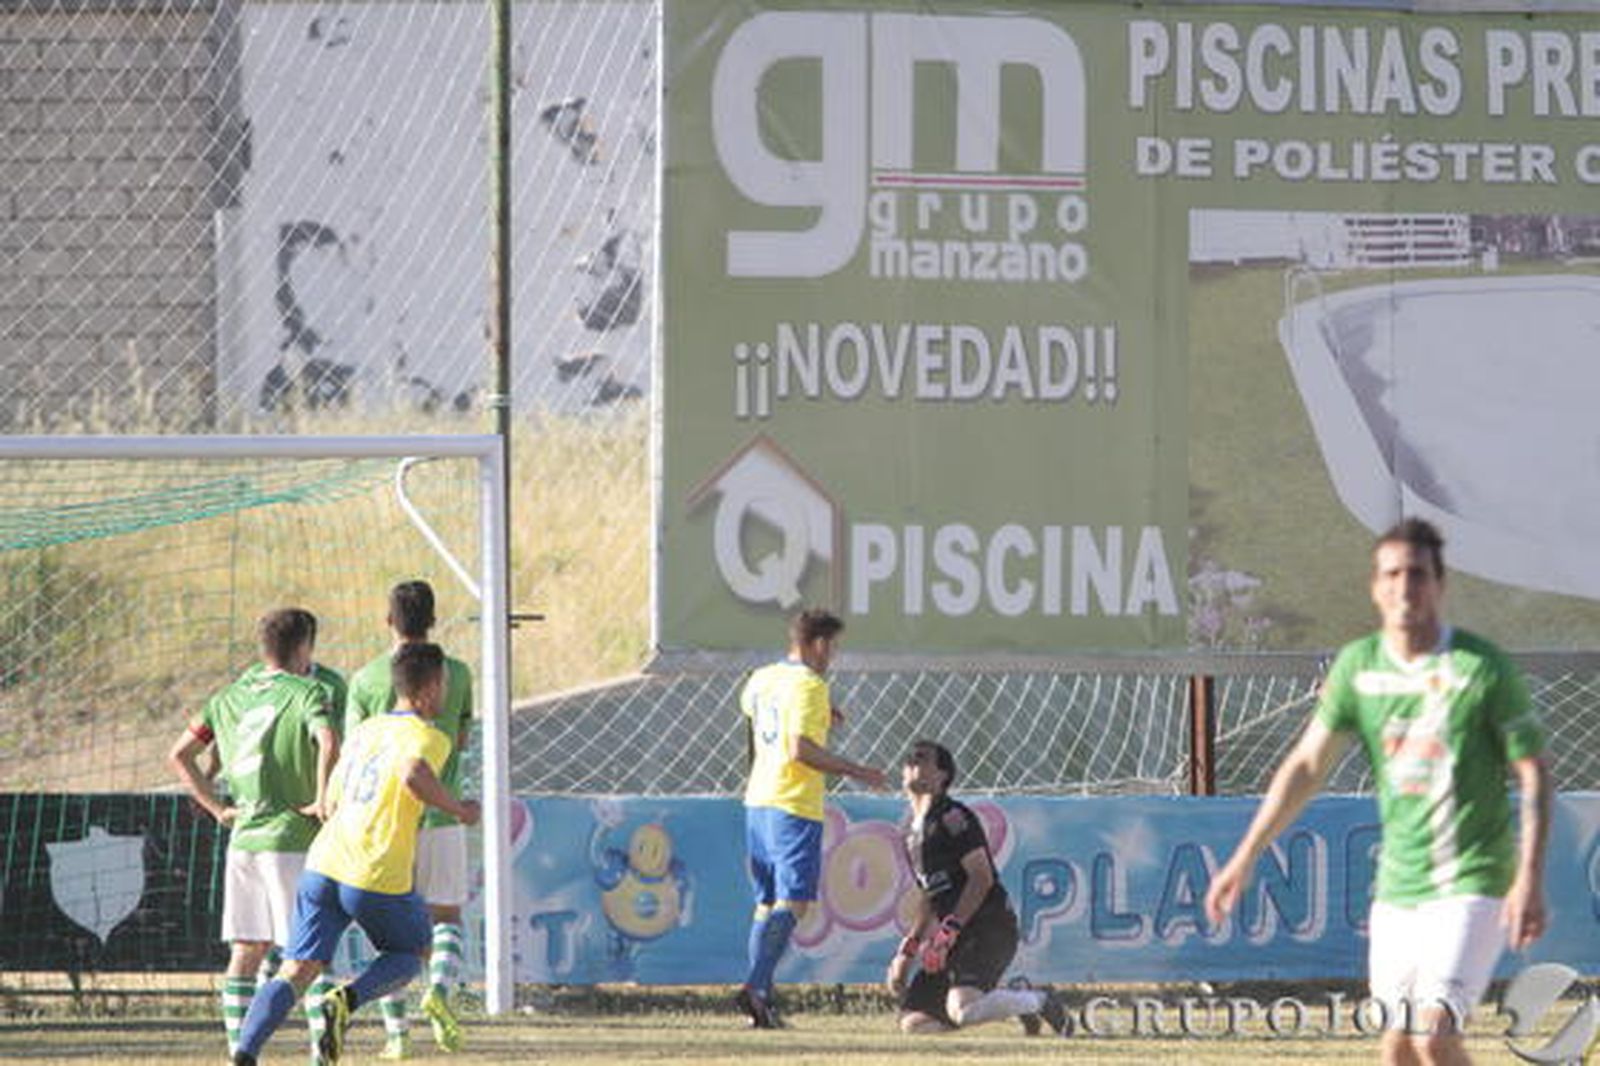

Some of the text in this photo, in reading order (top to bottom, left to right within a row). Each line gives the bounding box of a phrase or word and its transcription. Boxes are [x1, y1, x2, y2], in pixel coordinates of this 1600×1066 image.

[1129, 20, 1462, 116] PISCINAS
[712, 11, 1086, 278] gm
[1136, 136, 1212, 177] DE
[1235, 136, 1557, 184] POLIÉSTER
[869, 191, 1087, 240] grupo
[870, 238, 1087, 281] manzano
[851, 524, 1178, 616] PISCINA
